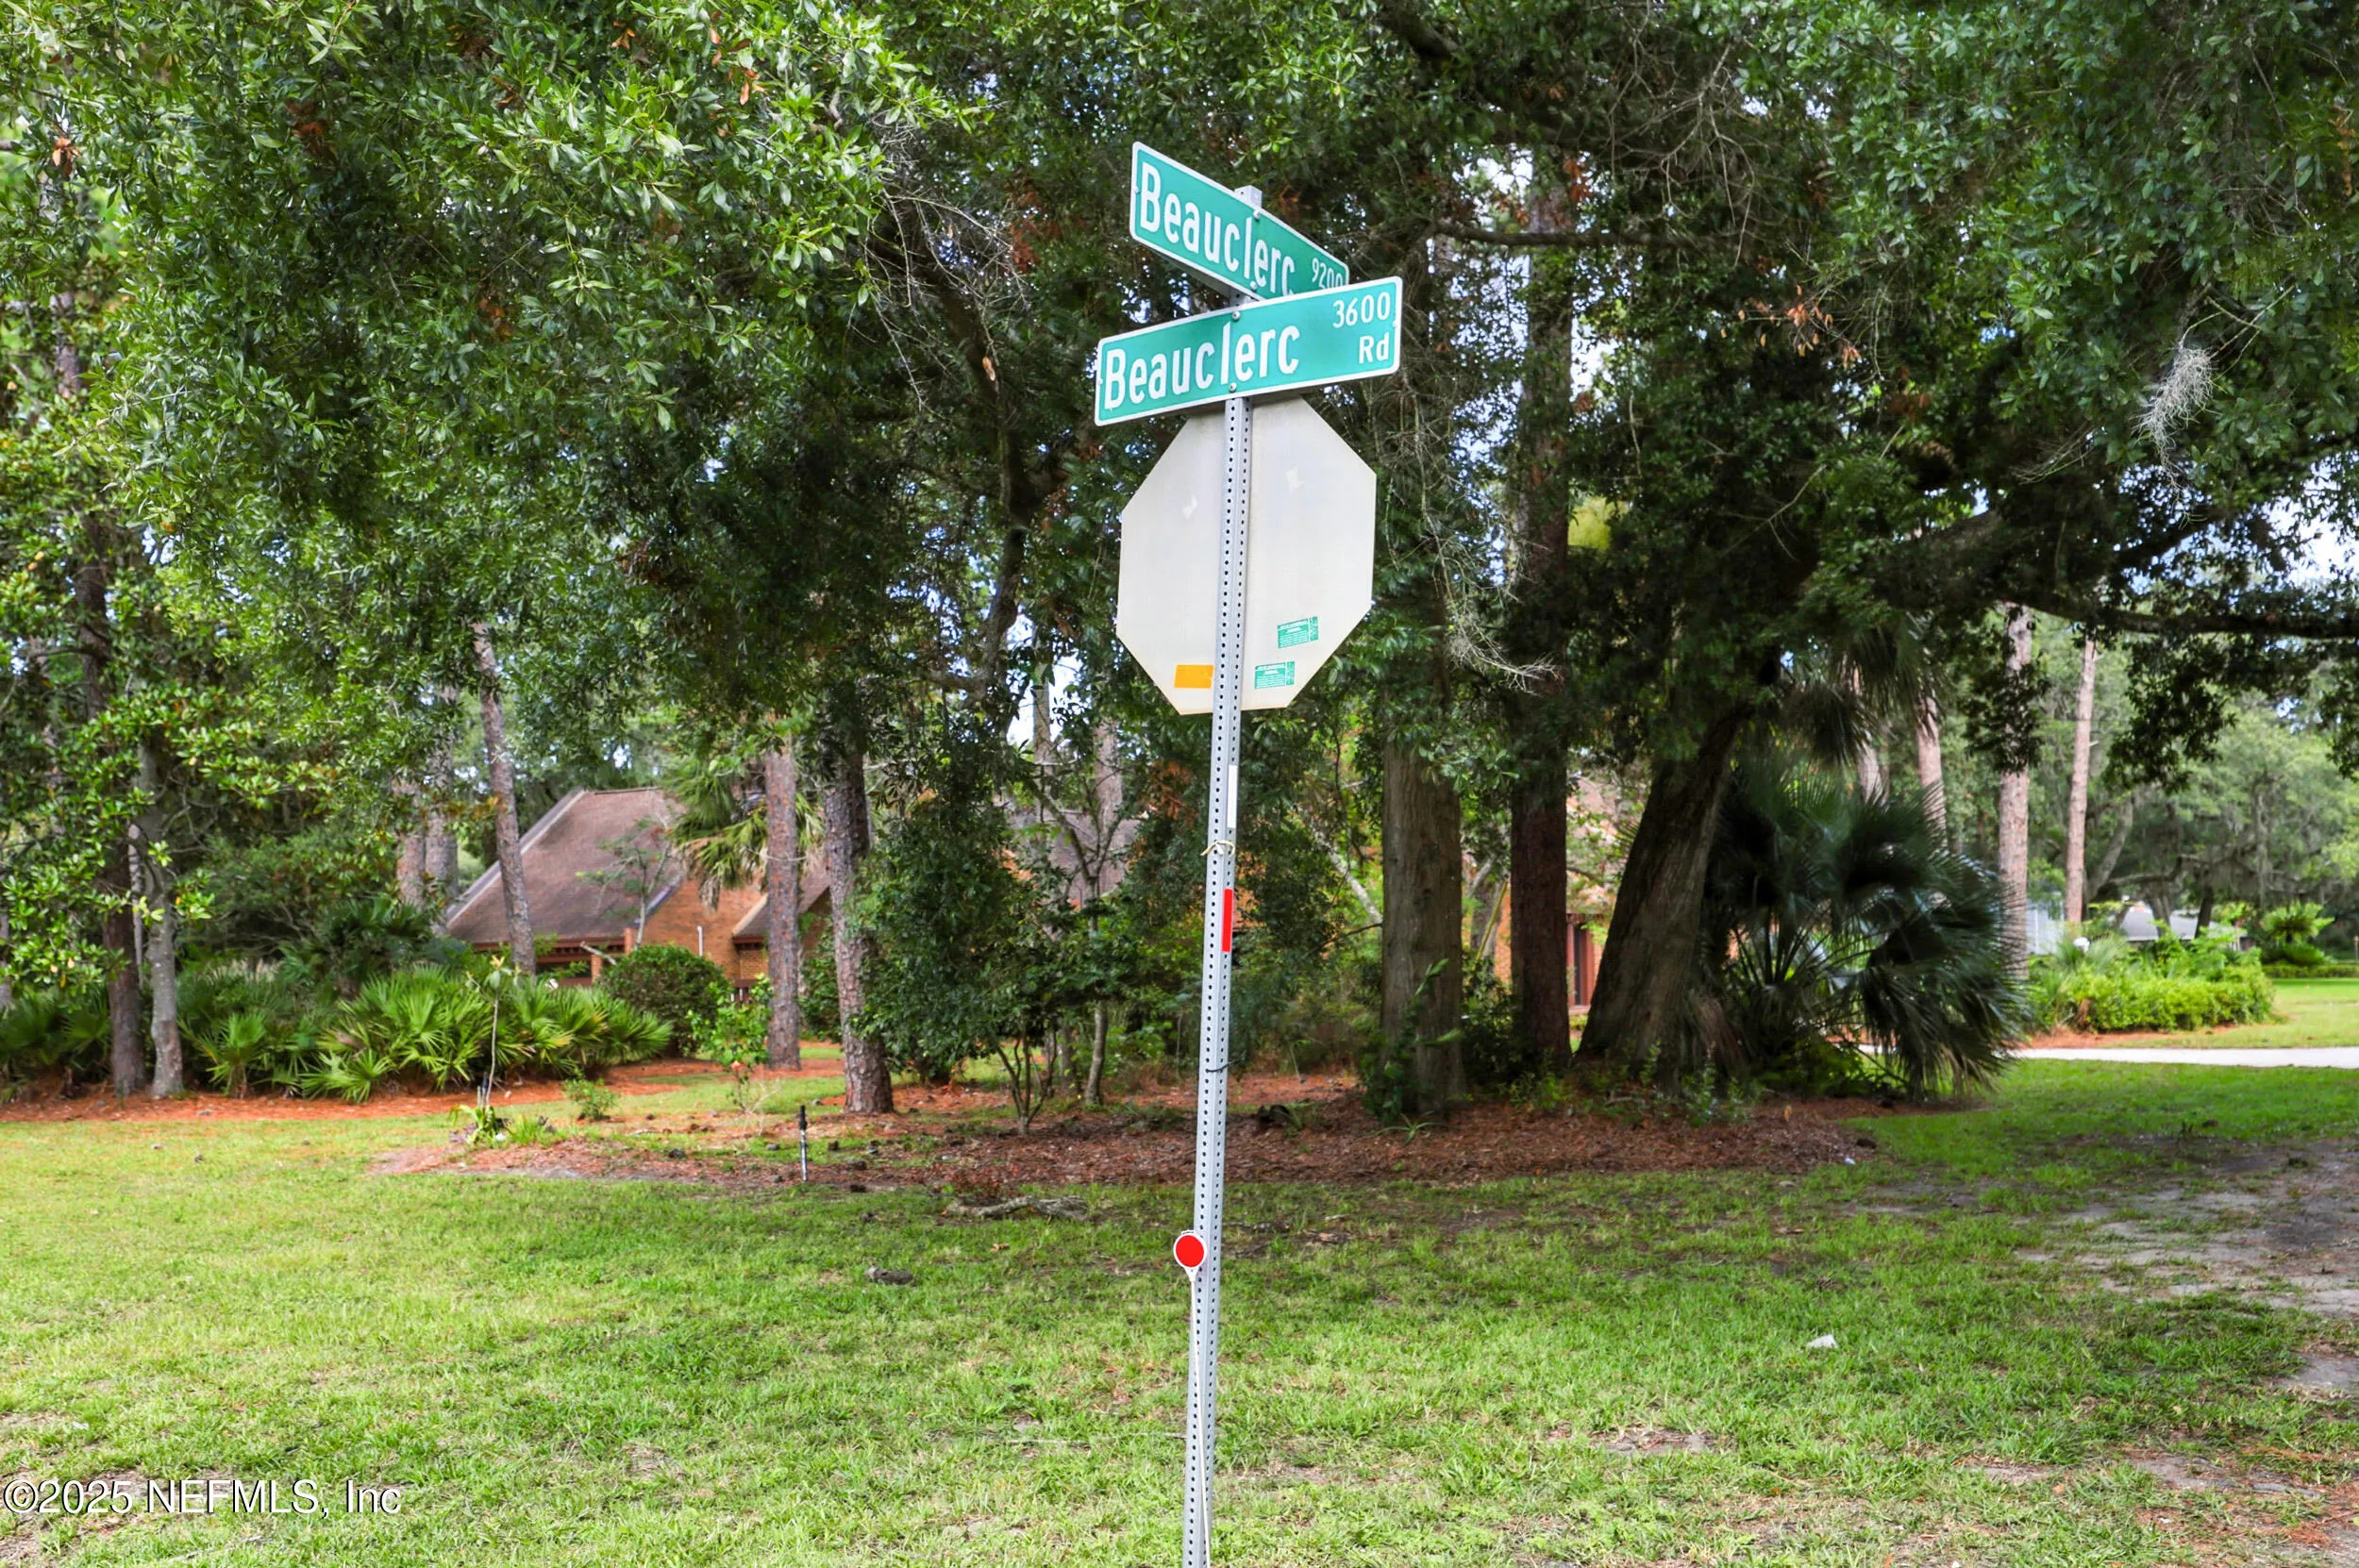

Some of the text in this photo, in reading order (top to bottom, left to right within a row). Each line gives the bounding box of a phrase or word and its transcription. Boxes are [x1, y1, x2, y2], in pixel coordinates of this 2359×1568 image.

[1140, 161, 1296, 297] Beauclerc
[1332, 292, 1391, 328] 3600
[1104, 322, 1300, 409] Beauclerc
[1358, 332, 1390, 364] Rd
